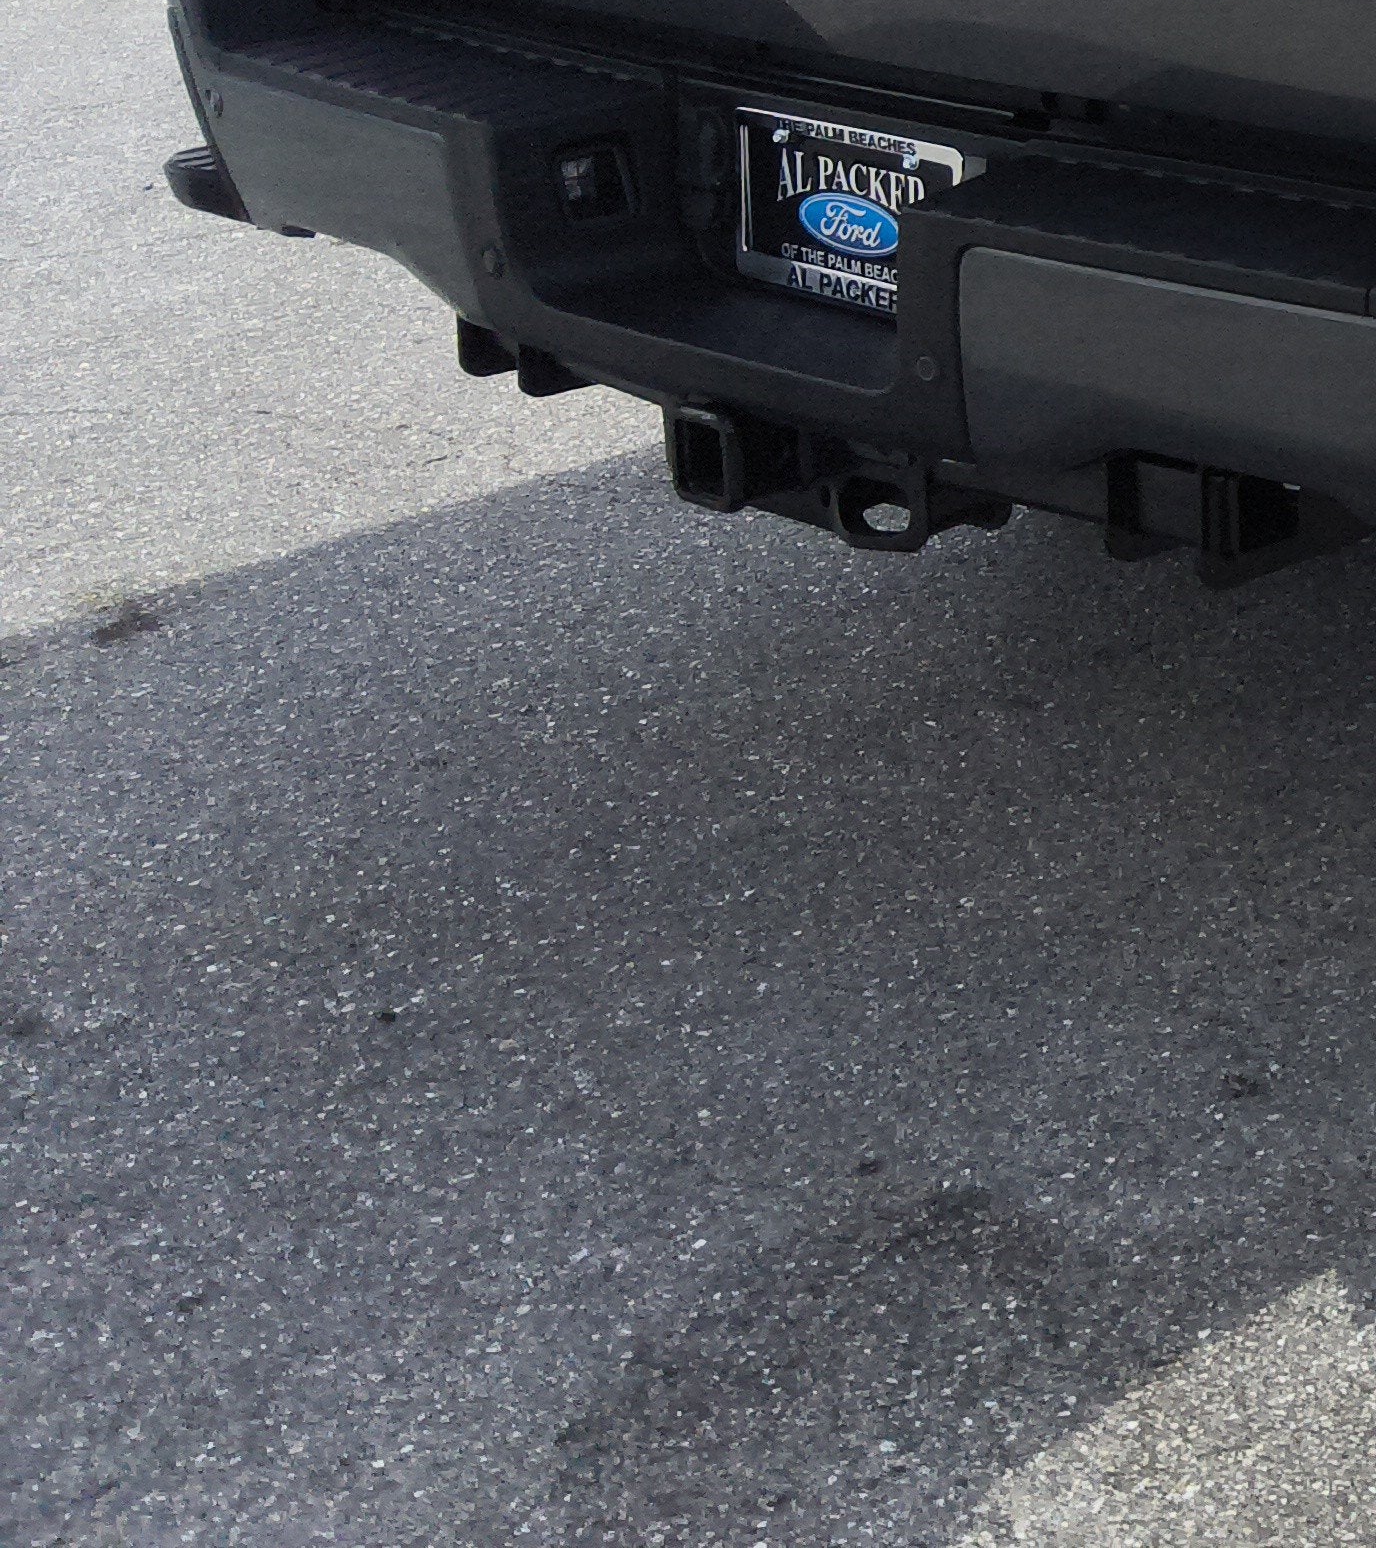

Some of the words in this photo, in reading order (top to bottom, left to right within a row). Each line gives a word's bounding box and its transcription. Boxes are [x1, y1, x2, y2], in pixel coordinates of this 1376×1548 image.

[805, 123, 845, 142] PALM
[849, 130, 917, 156] BEACHES
[776, 147, 813, 202] AL
[819, 201, 883, 248] Ford
[781, 242, 799, 259] OF
[800, 246, 826, 266] THE
[827, 253, 862, 275] PALM
[864, 262, 898, 283] BEAC
[786, 264, 814, 290] AL
